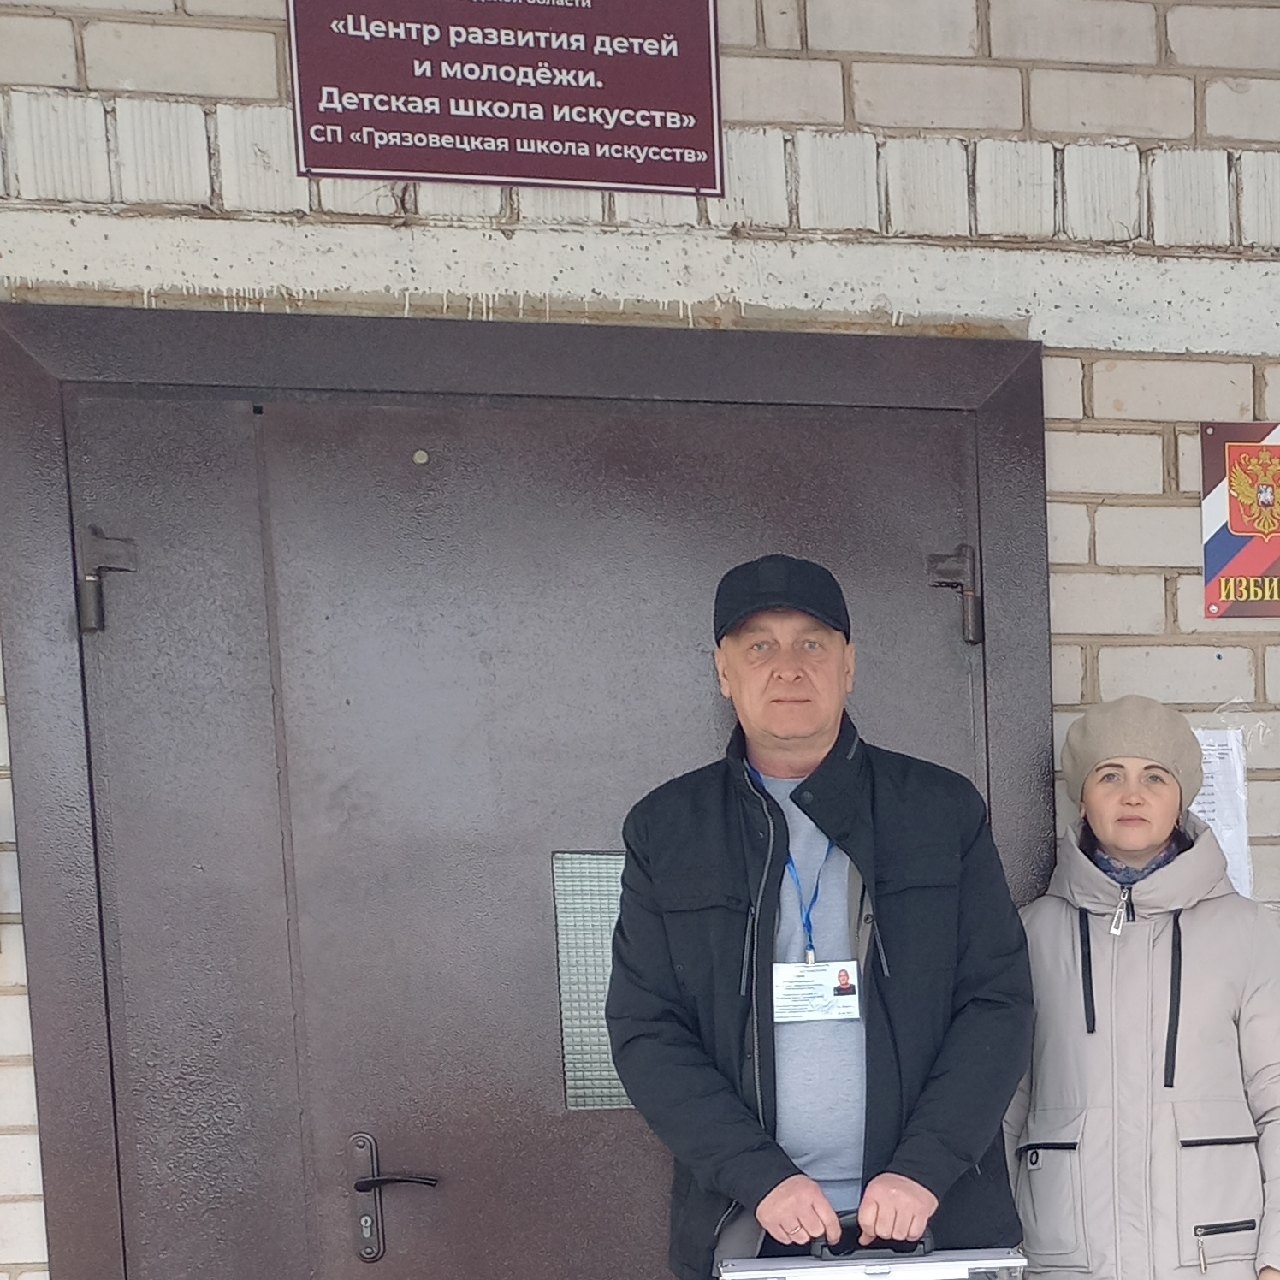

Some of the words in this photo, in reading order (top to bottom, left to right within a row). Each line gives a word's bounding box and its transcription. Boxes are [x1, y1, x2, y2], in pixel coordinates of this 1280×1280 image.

[330, 14, 441, 46] «Центр
[449, 24, 585, 51] развития
[594, 33, 679, 57] детей
[413, 59, 432, 77] и
[441, 61, 604, 88] молодёжи.
[318, 86, 441, 115] Детская
[450, 97, 544, 121] школа
[553, 104, 696, 130] искусств»
[310, 124, 343, 143] СП
[350, 126, 510, 152] «Грязовецкая
[516, 138, 590, 157] школа
[596, 143, 708, 164] искусств»
